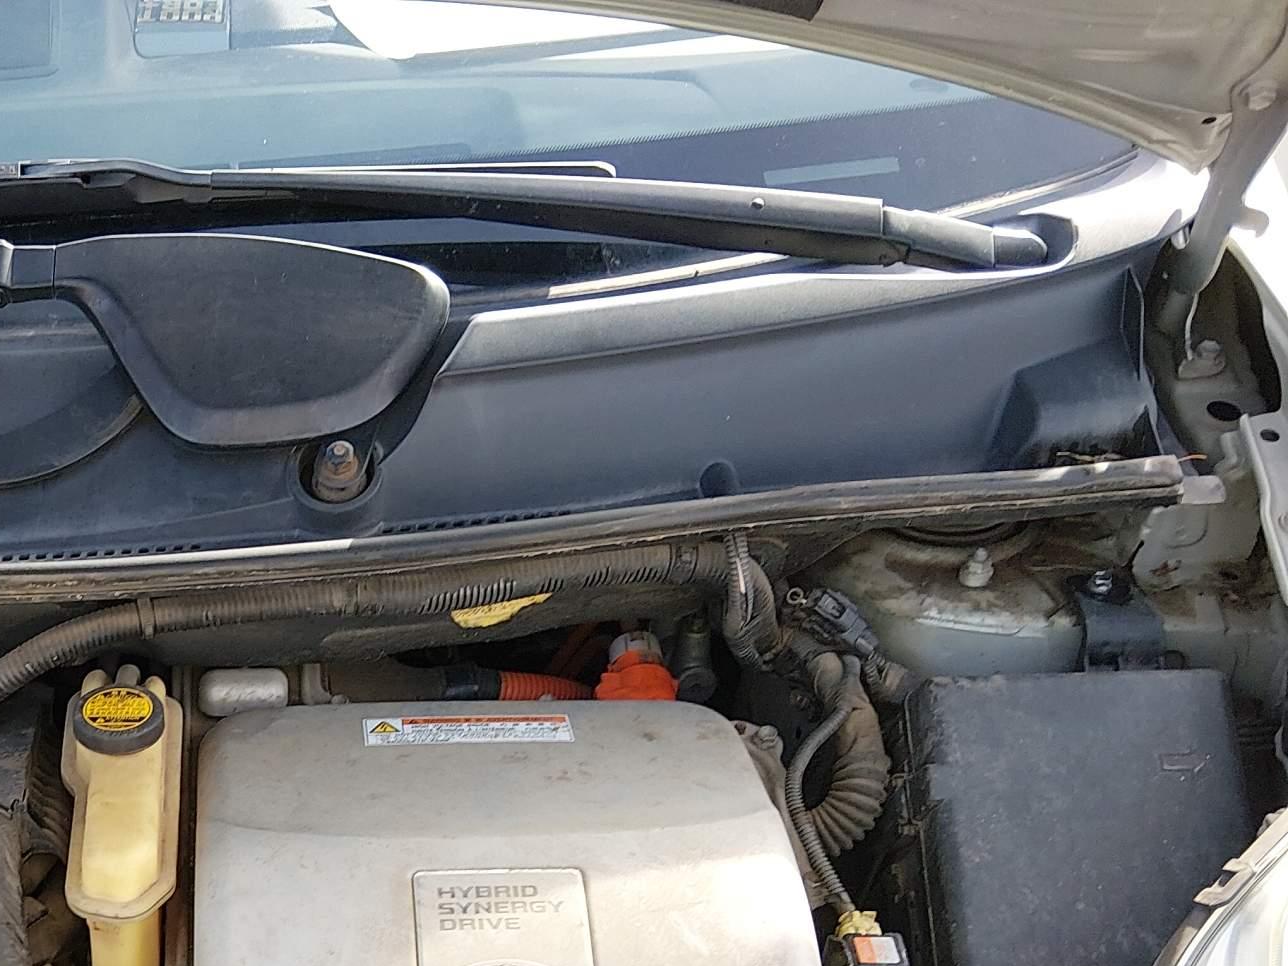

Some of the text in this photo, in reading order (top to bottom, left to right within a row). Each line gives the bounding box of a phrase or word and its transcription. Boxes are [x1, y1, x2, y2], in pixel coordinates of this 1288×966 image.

[437, 884, 539, 899] HYBRID
[438, 901, 564, 915] SYNERGY
[439, 917, 521, 931] DRIVE
